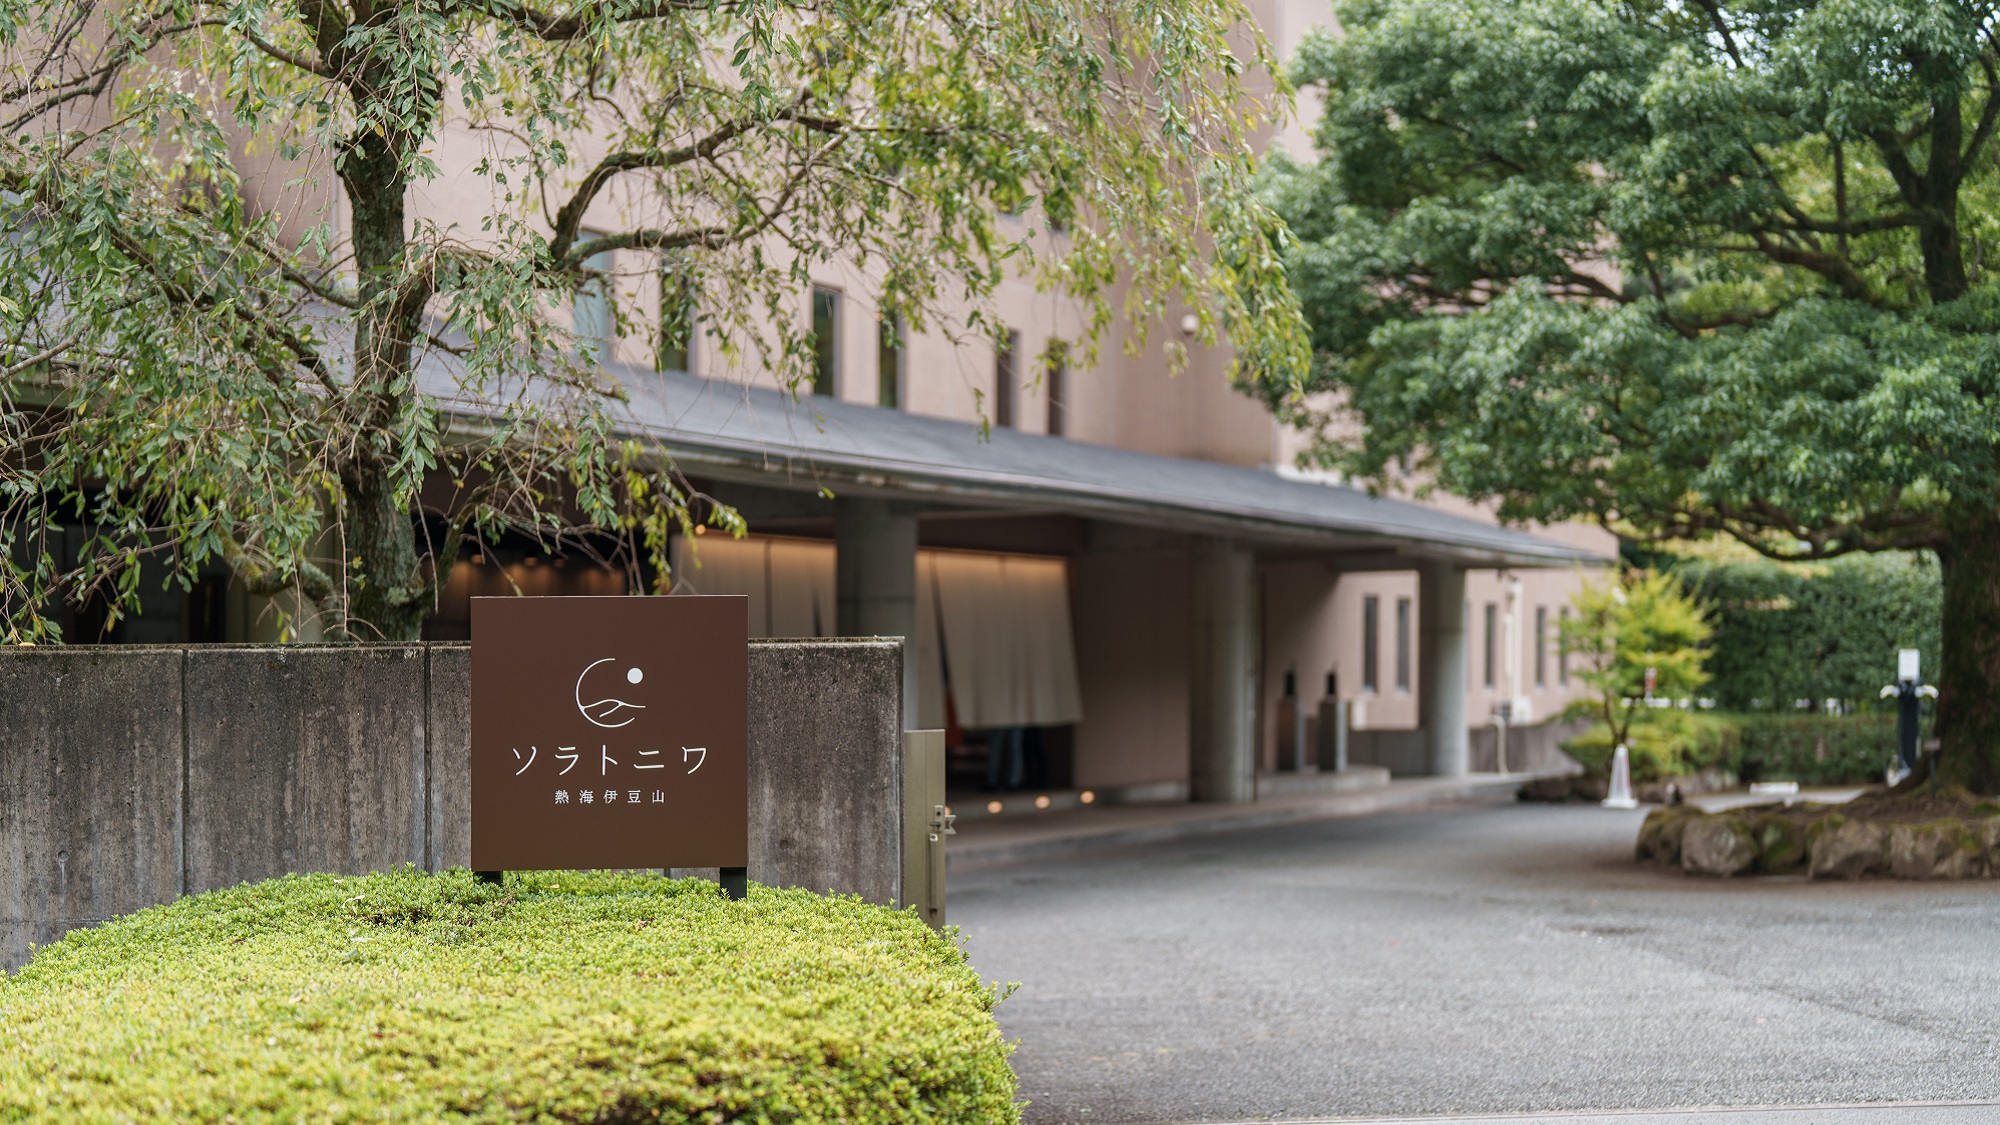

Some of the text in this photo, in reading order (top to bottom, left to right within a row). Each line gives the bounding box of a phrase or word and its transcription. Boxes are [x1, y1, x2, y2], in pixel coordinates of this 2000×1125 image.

[512, 744, 707, 776] ソラトニワ
[554, 789, 665, 804] 熱海伊豆山
